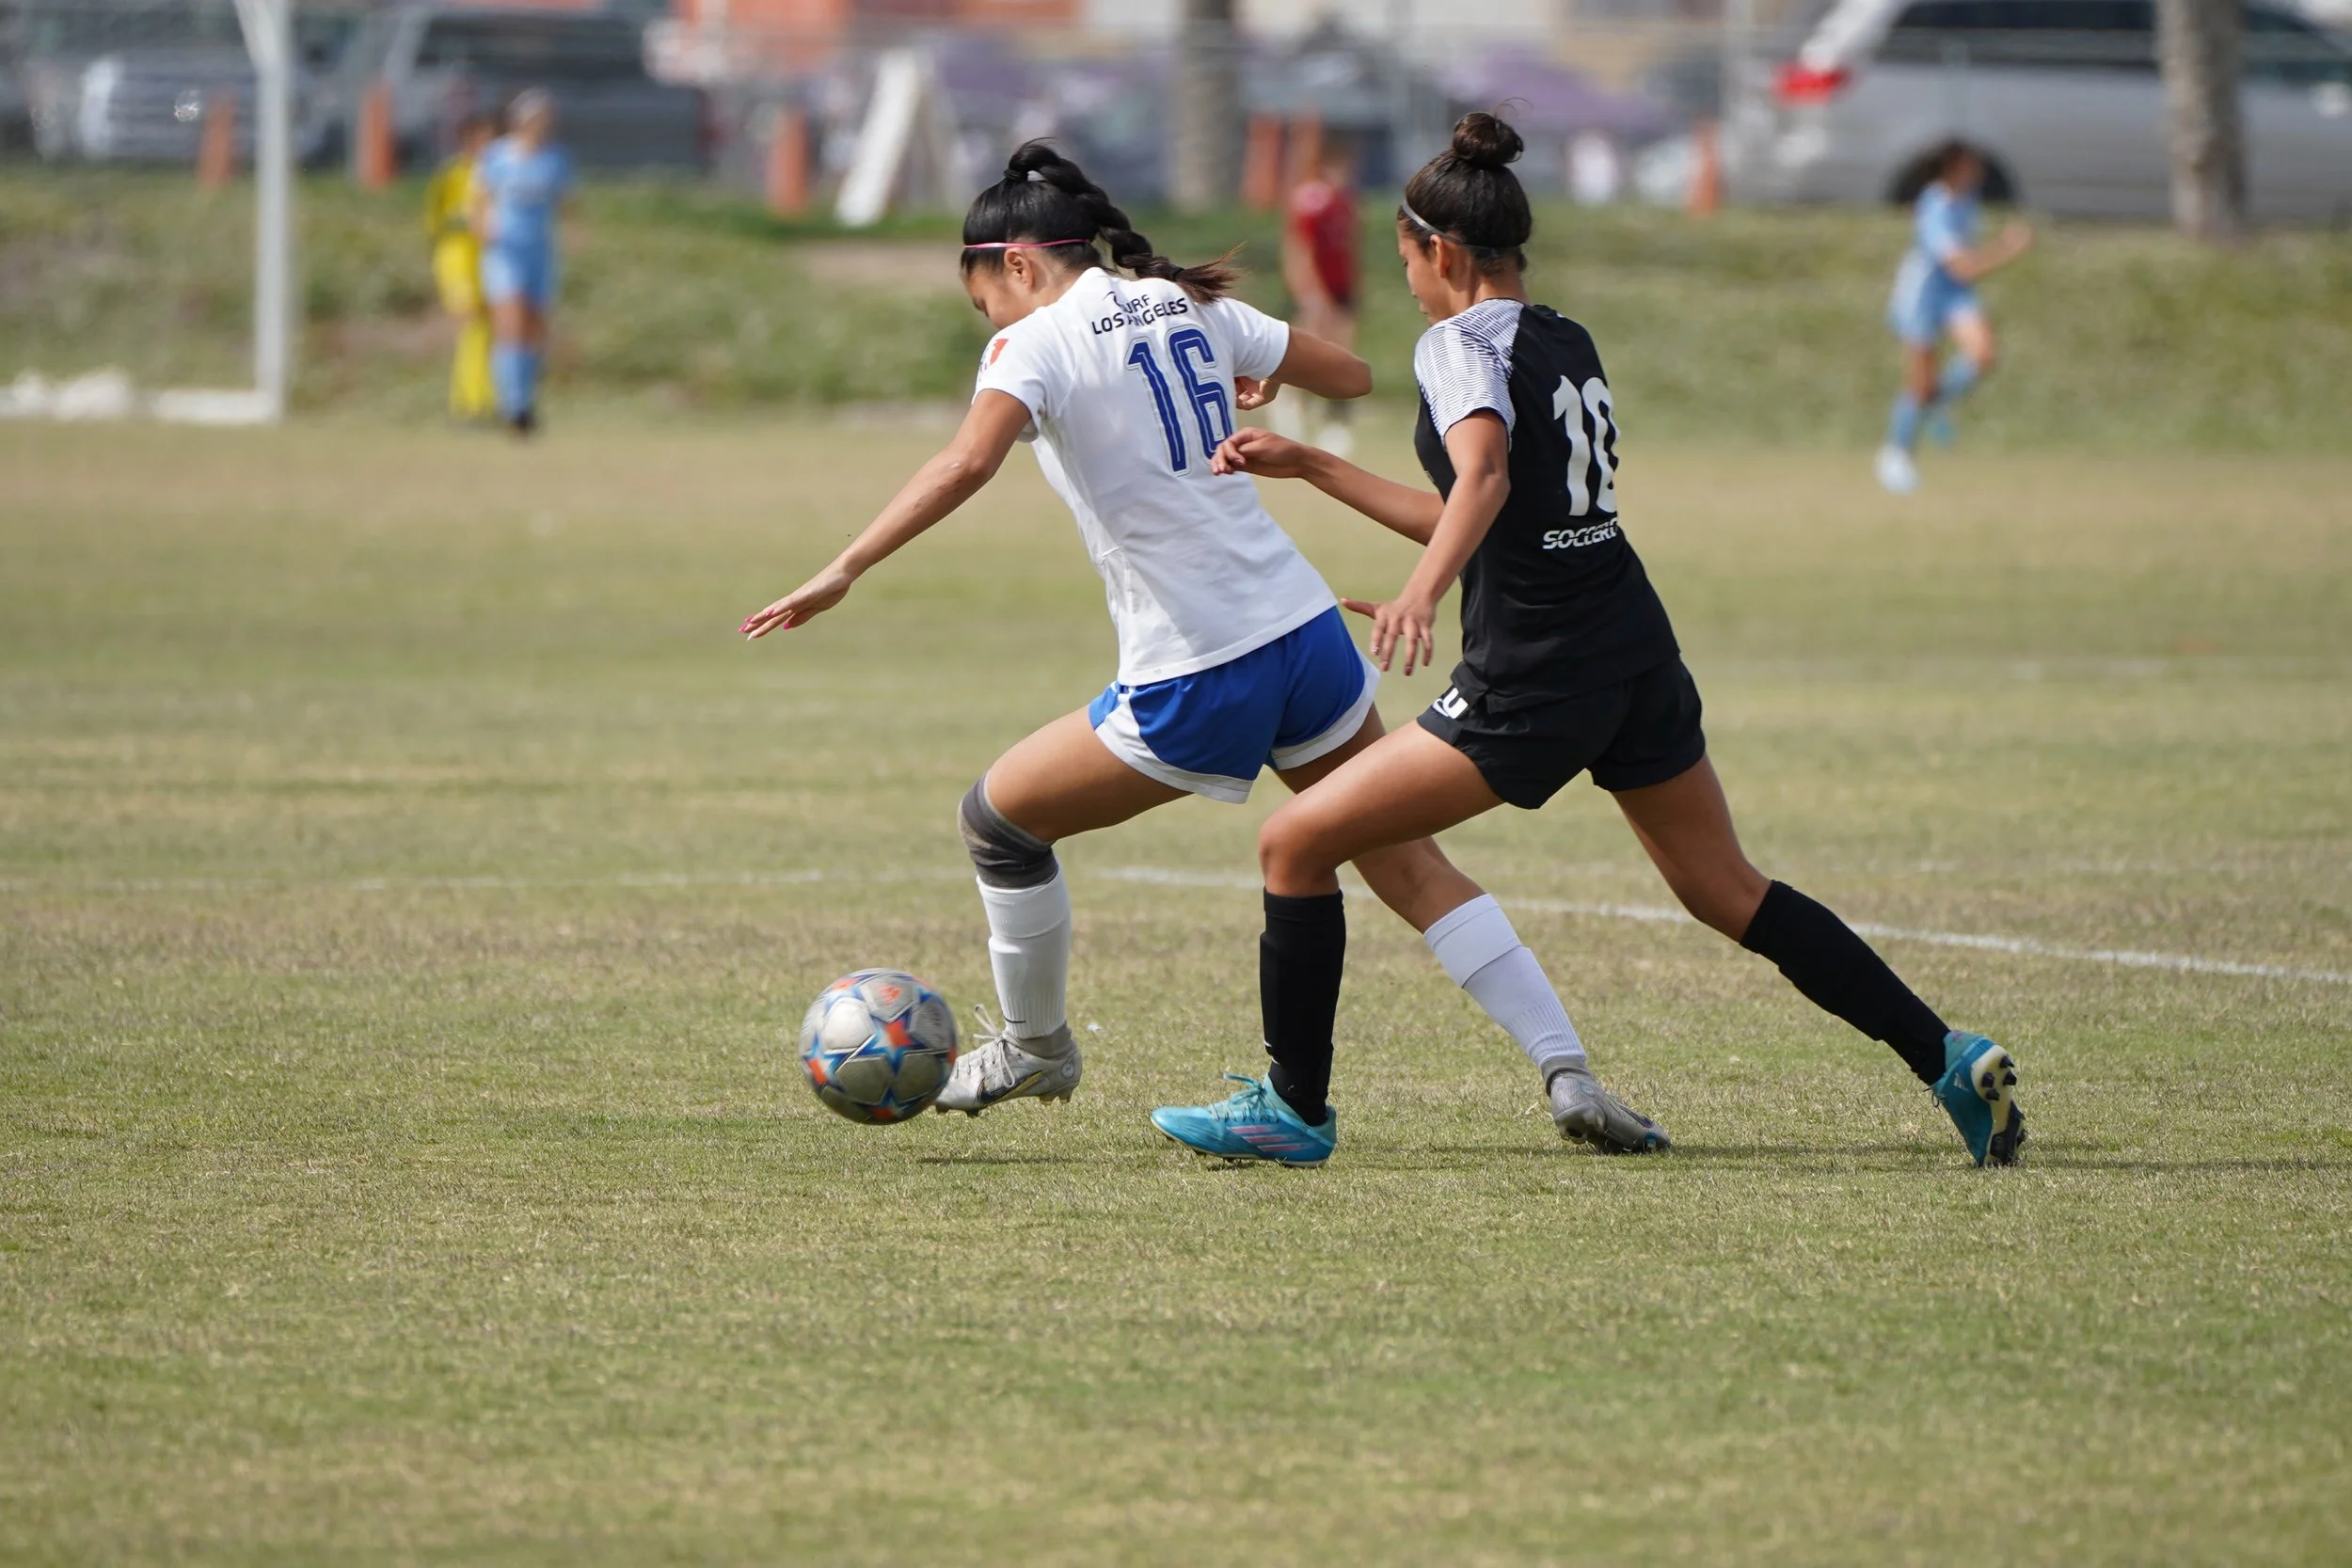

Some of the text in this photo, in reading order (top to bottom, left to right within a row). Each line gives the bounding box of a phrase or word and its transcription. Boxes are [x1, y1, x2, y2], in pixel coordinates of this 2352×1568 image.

[1091, 297, 1188, 335] LOS ANGELES
[1127, 328, 1233, 473] 16
[1552, 375, 1621, 516] 10
